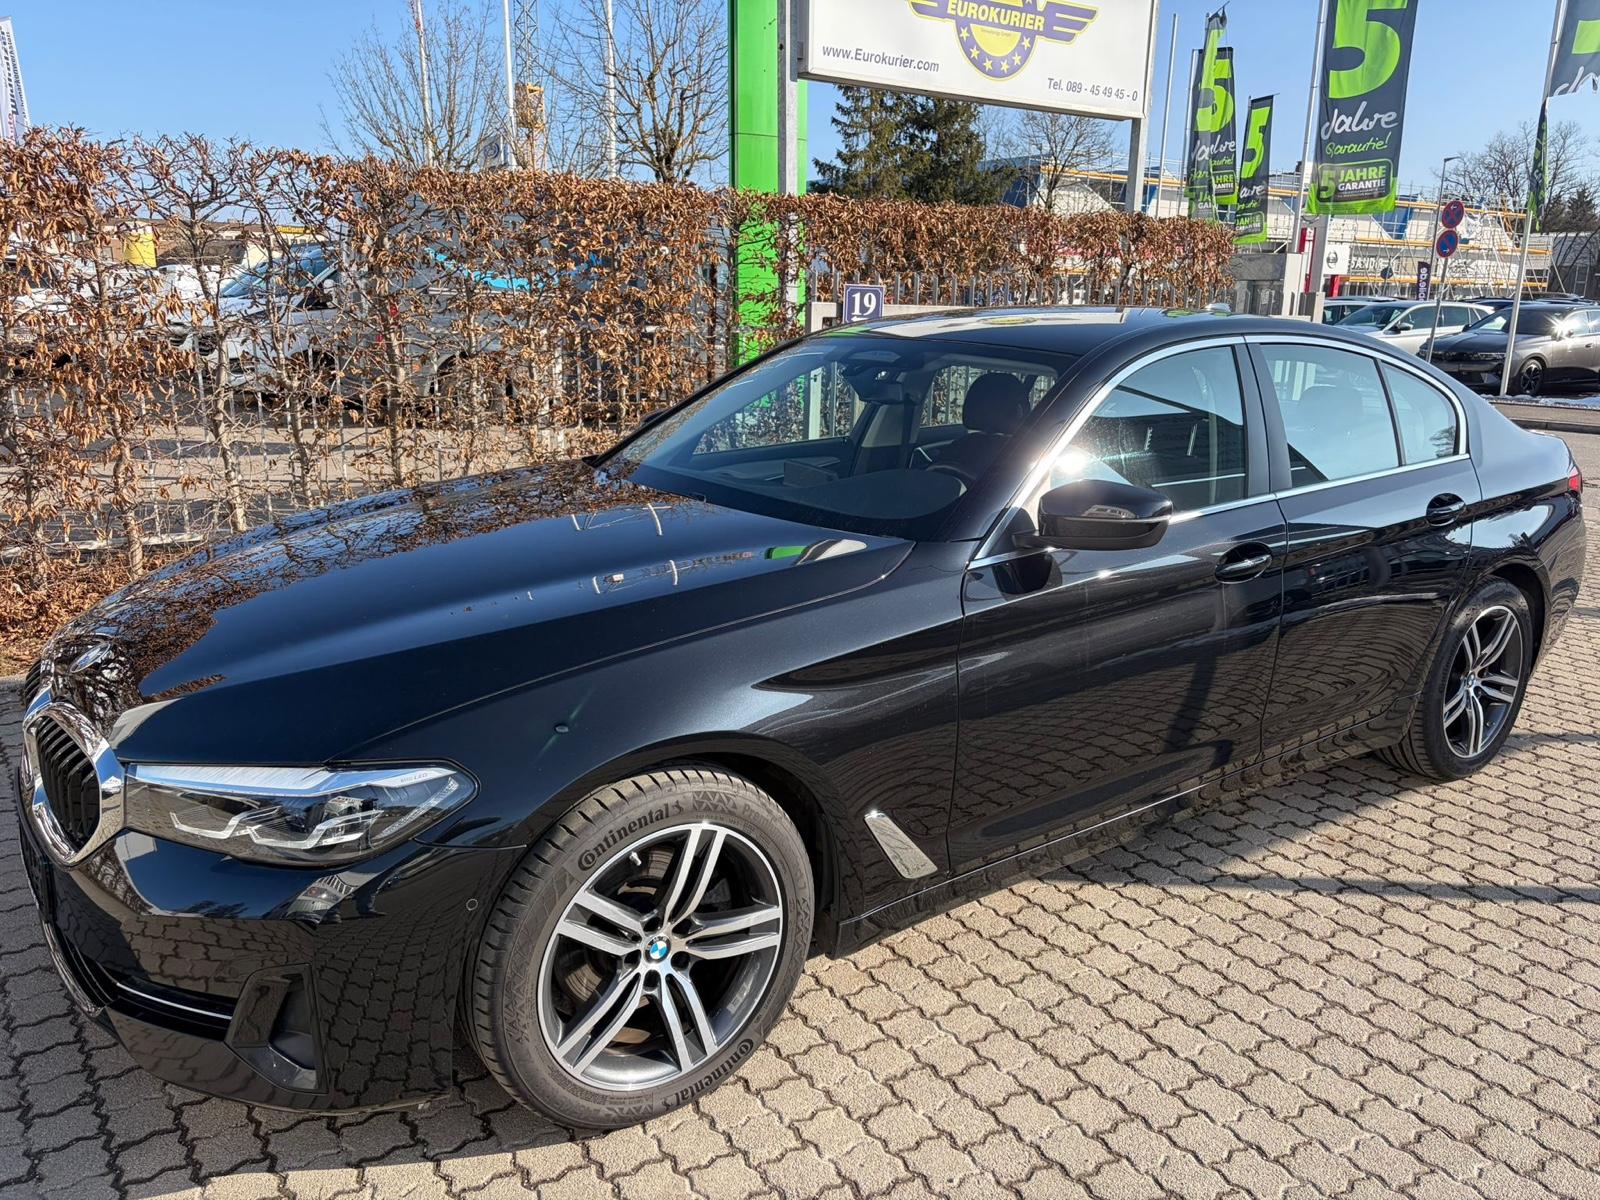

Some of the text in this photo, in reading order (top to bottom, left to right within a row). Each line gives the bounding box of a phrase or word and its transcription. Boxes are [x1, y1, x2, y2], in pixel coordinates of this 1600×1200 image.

[947, 2, 1045, 32] EUROKURIER
[822, 45, 940, 73] www.Eurokurier.com
[1328, 0, 1407, 98] 5
[1047, 78, 1064, 91] Tel.
[1066, 80, 1083, 94] 089
[1090, 84, 1101, 96] 45
[1102, 86, 1113, 98] 49
[1114, 88, 1125, 100] 45
[1132, 90, 1138, 102] 0
[1320, 169, 1336, 199] 5
[1339, 165, 1387, 182] JAHRE
[1338, 178, 1387, 191] GARANTIE
[851, 292, 877, 315] 19
[577, 803, 670, 872] Continental
[675, 1038, 754, 1106] Continental
